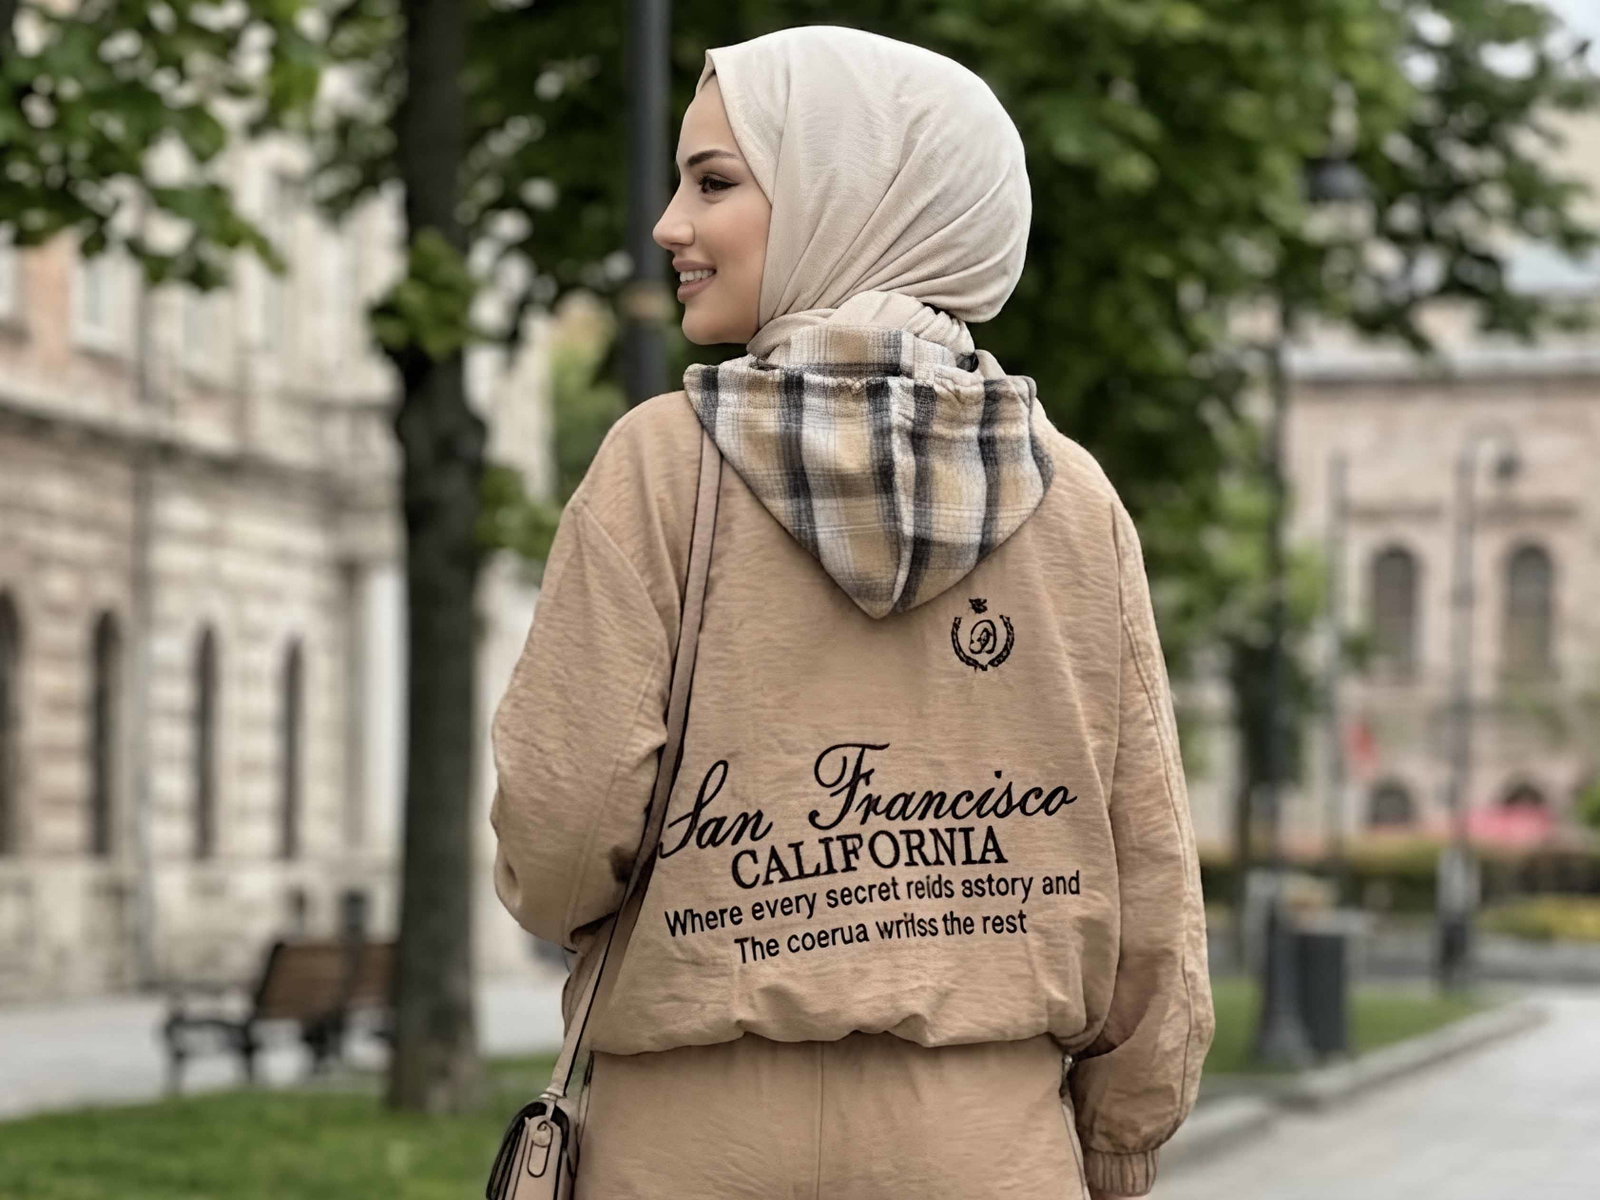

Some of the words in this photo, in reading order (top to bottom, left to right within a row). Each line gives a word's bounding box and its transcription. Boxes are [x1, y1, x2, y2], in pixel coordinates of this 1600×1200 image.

[659, 760, 773, 859] San
[808, 743, 1077, 830] Francisco
[731, 825, 1009, 889] CALIFORNIA
[664, 906, 743, 937] Where
[751, 893, 817, 919] every
[825, 876, 901, 908] secret
[1042, 870, 1081, 895] and
[734, 936, 780, 964] The
[942, 910, 975, 936] the
[982, 909, 1028, 935] rest
